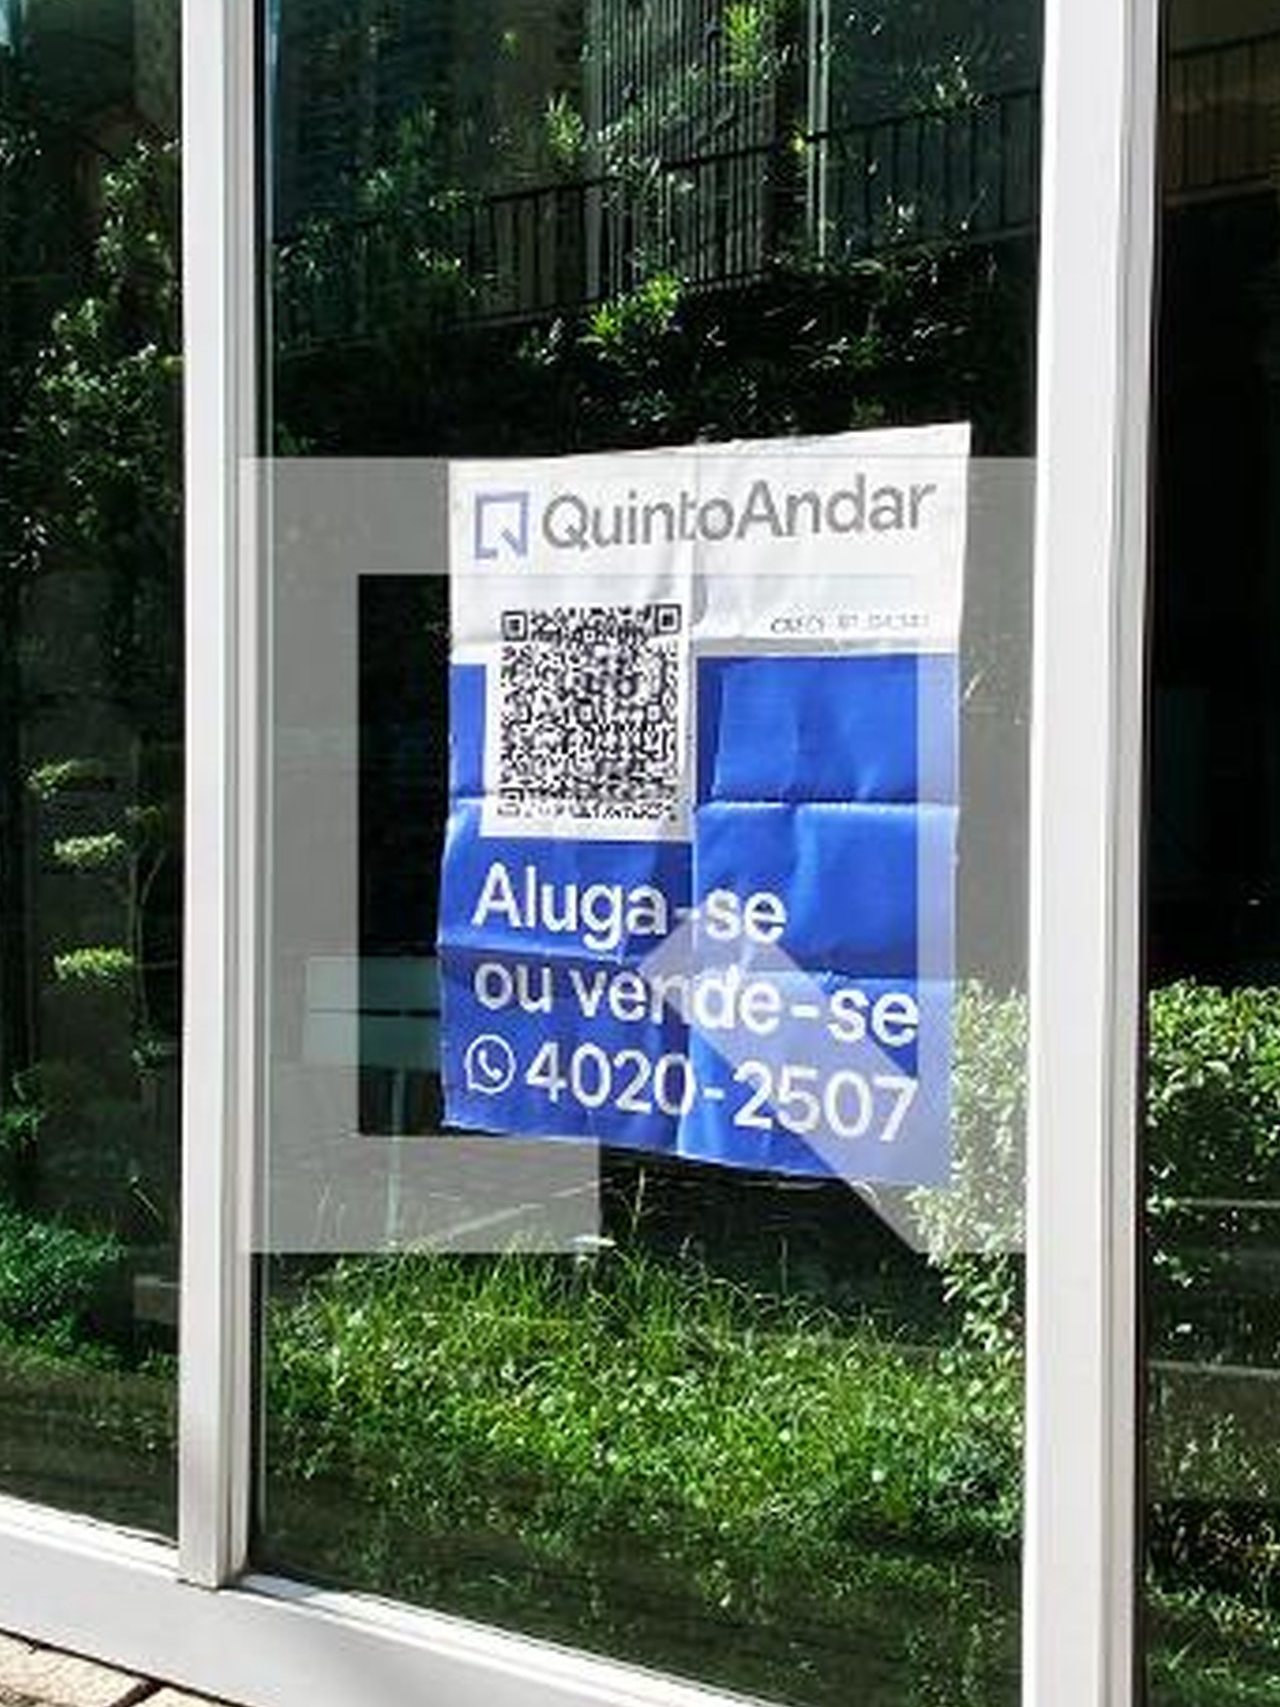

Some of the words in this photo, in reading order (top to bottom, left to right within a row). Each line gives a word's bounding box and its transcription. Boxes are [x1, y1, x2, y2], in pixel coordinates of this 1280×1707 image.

[541, 473, 938, 552] QuintoAndar
[471, 860, 788, 951] Aluga-se
[472, 961, 552, 1014] ou
[570, 963, 921, 1048] vende-se
[524, 1040, 920, 1144] 4020-2507
